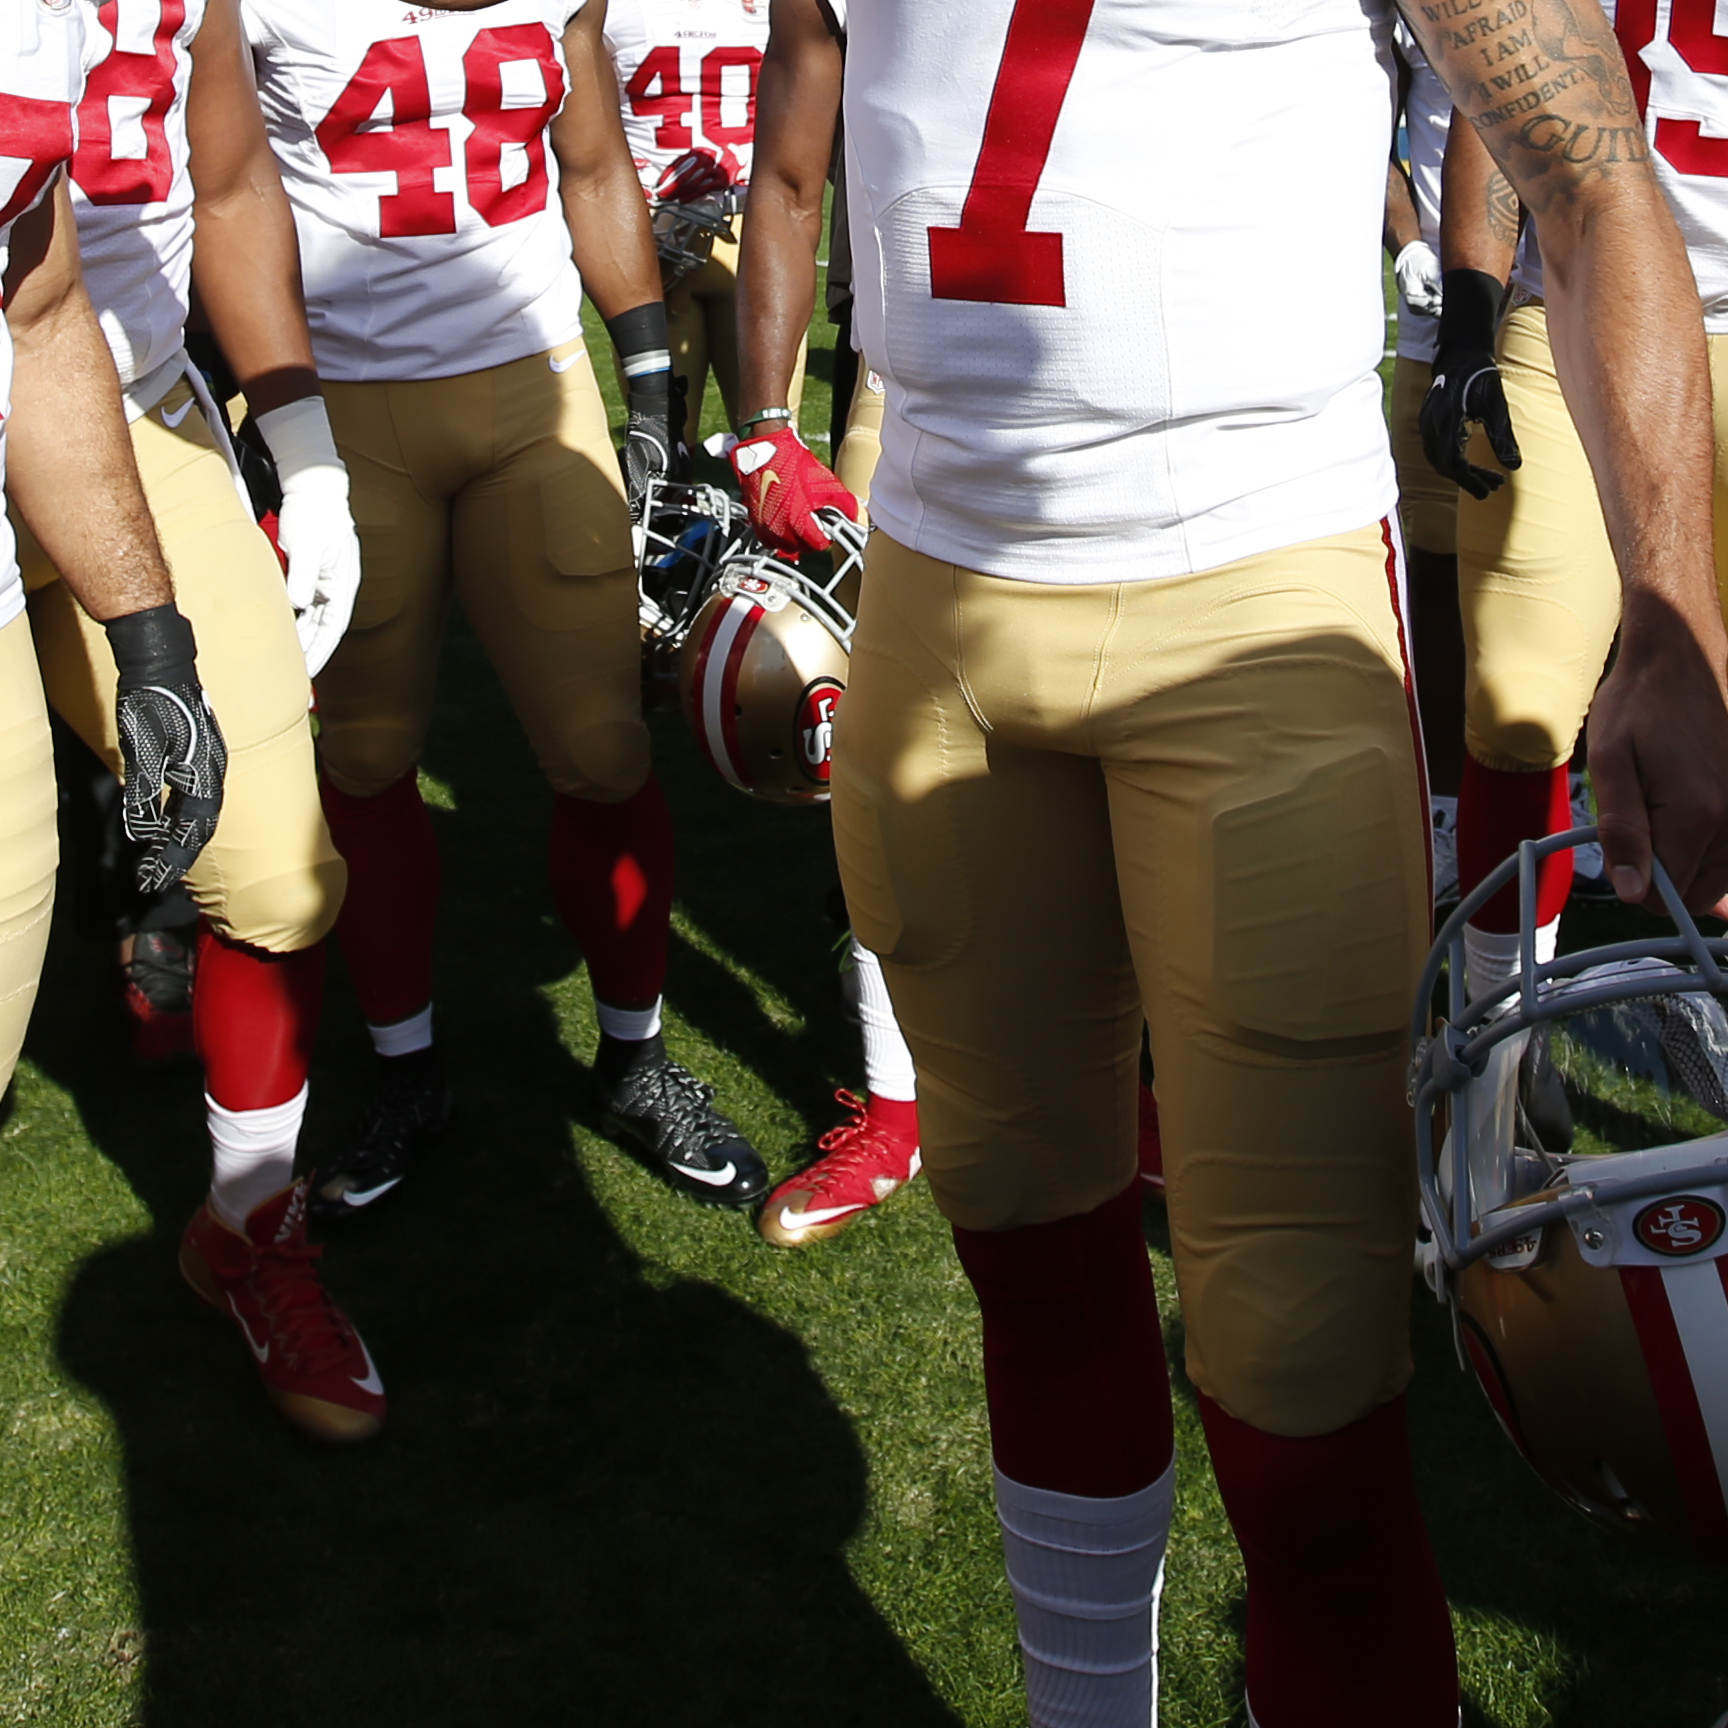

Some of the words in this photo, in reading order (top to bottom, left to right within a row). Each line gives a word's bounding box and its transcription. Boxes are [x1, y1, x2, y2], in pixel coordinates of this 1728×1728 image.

[1453, 0, 1527, 49] AFRAID
[1498, 29, 1532, 61] AM
[1491, 55, 1549, 90] WILL
[625, 46, 765, 149] 40
[315, 21, 565, 238] 48
